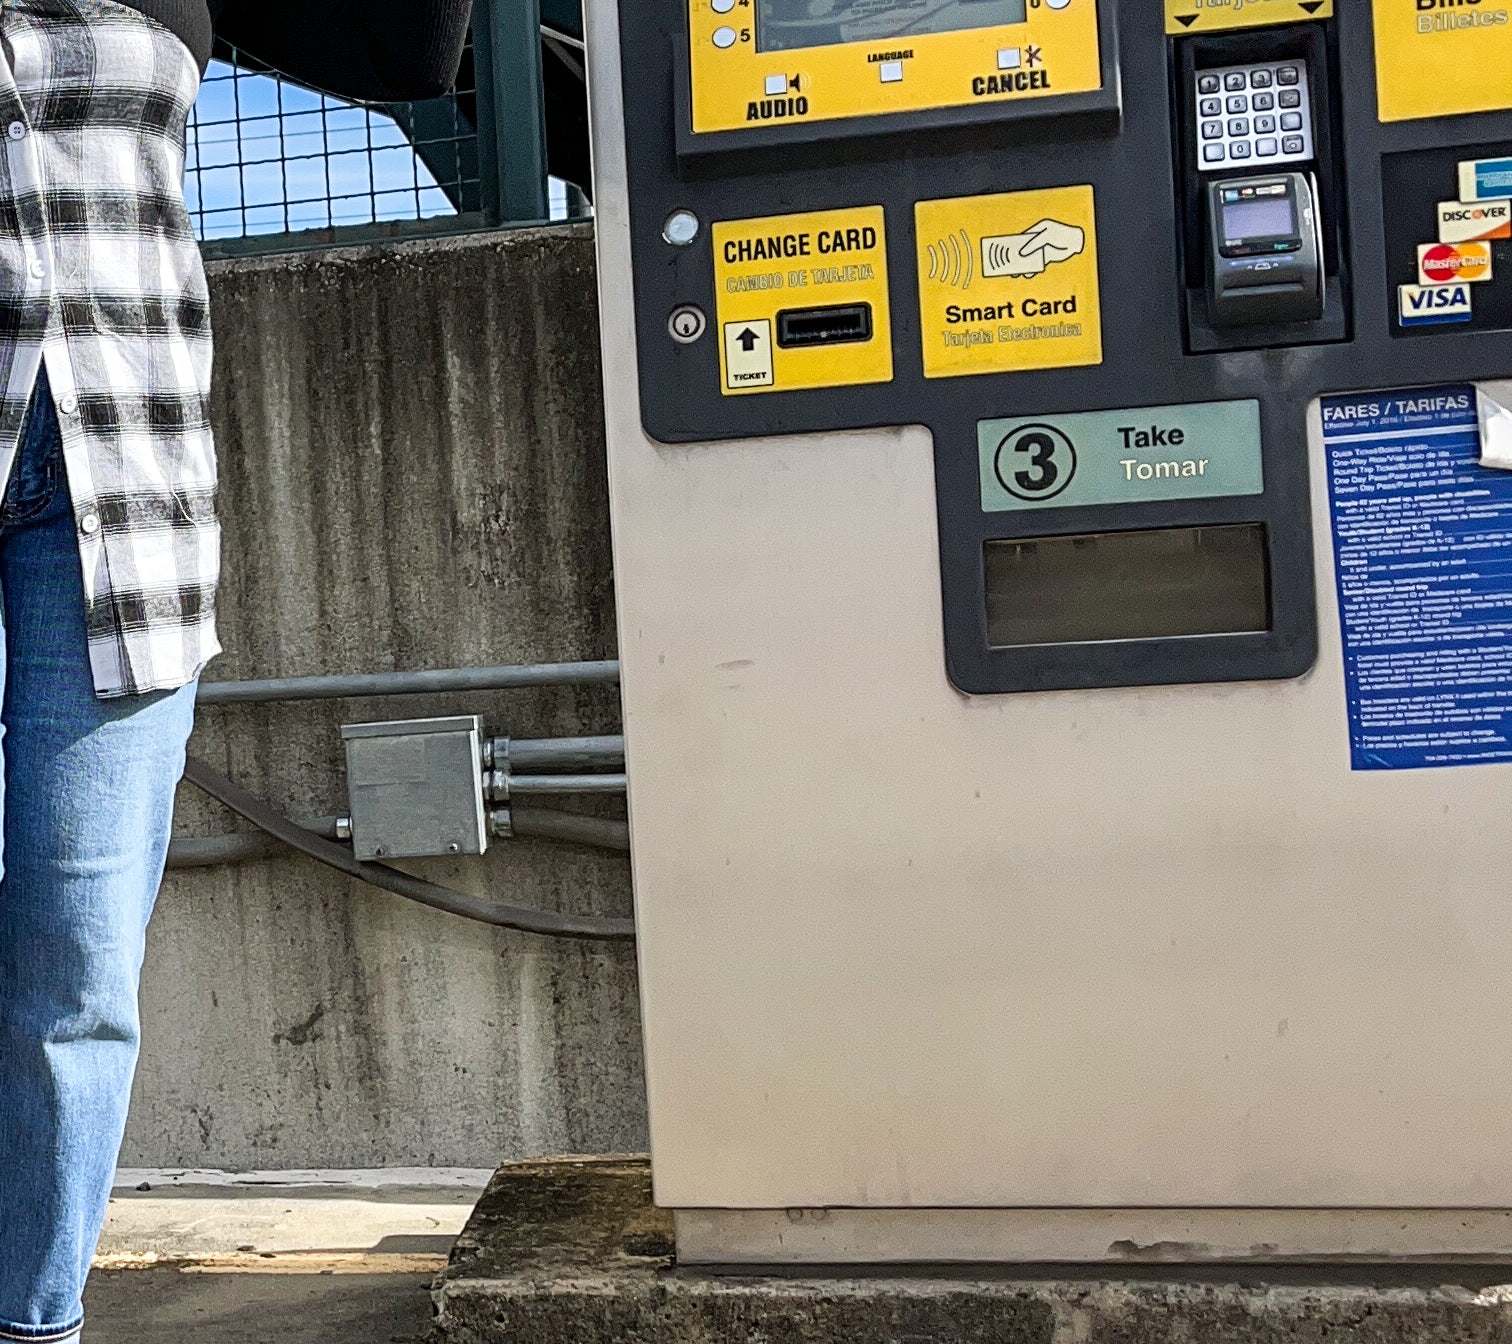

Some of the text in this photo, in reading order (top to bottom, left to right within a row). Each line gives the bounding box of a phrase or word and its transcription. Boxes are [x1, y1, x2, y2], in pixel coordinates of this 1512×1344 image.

[1417, 8, 1509, 34] Billetes
[740, 28, 751, 43] 5
[972, 69, 1051, 96] CANCEL
[746, 96, 809, 121] AUDIO
[1442, 206, 1507, 223] DISCOVER
[723, 226, 877, 265] CHANGE CARD
[944, 295, 1078, 324] Smart Card
[1407, 287, 1469, 310] VISA
[733, 370, 768, 382] TICKET
[1323, 403, 1380, 422] FARES
[1395, 395, 1469, 414] TARIFAS
[1117, 425, 1185, 449] Take
[1014, 432, 1058, 492] 3
[1119, 458, 1209, 481] Tomar
